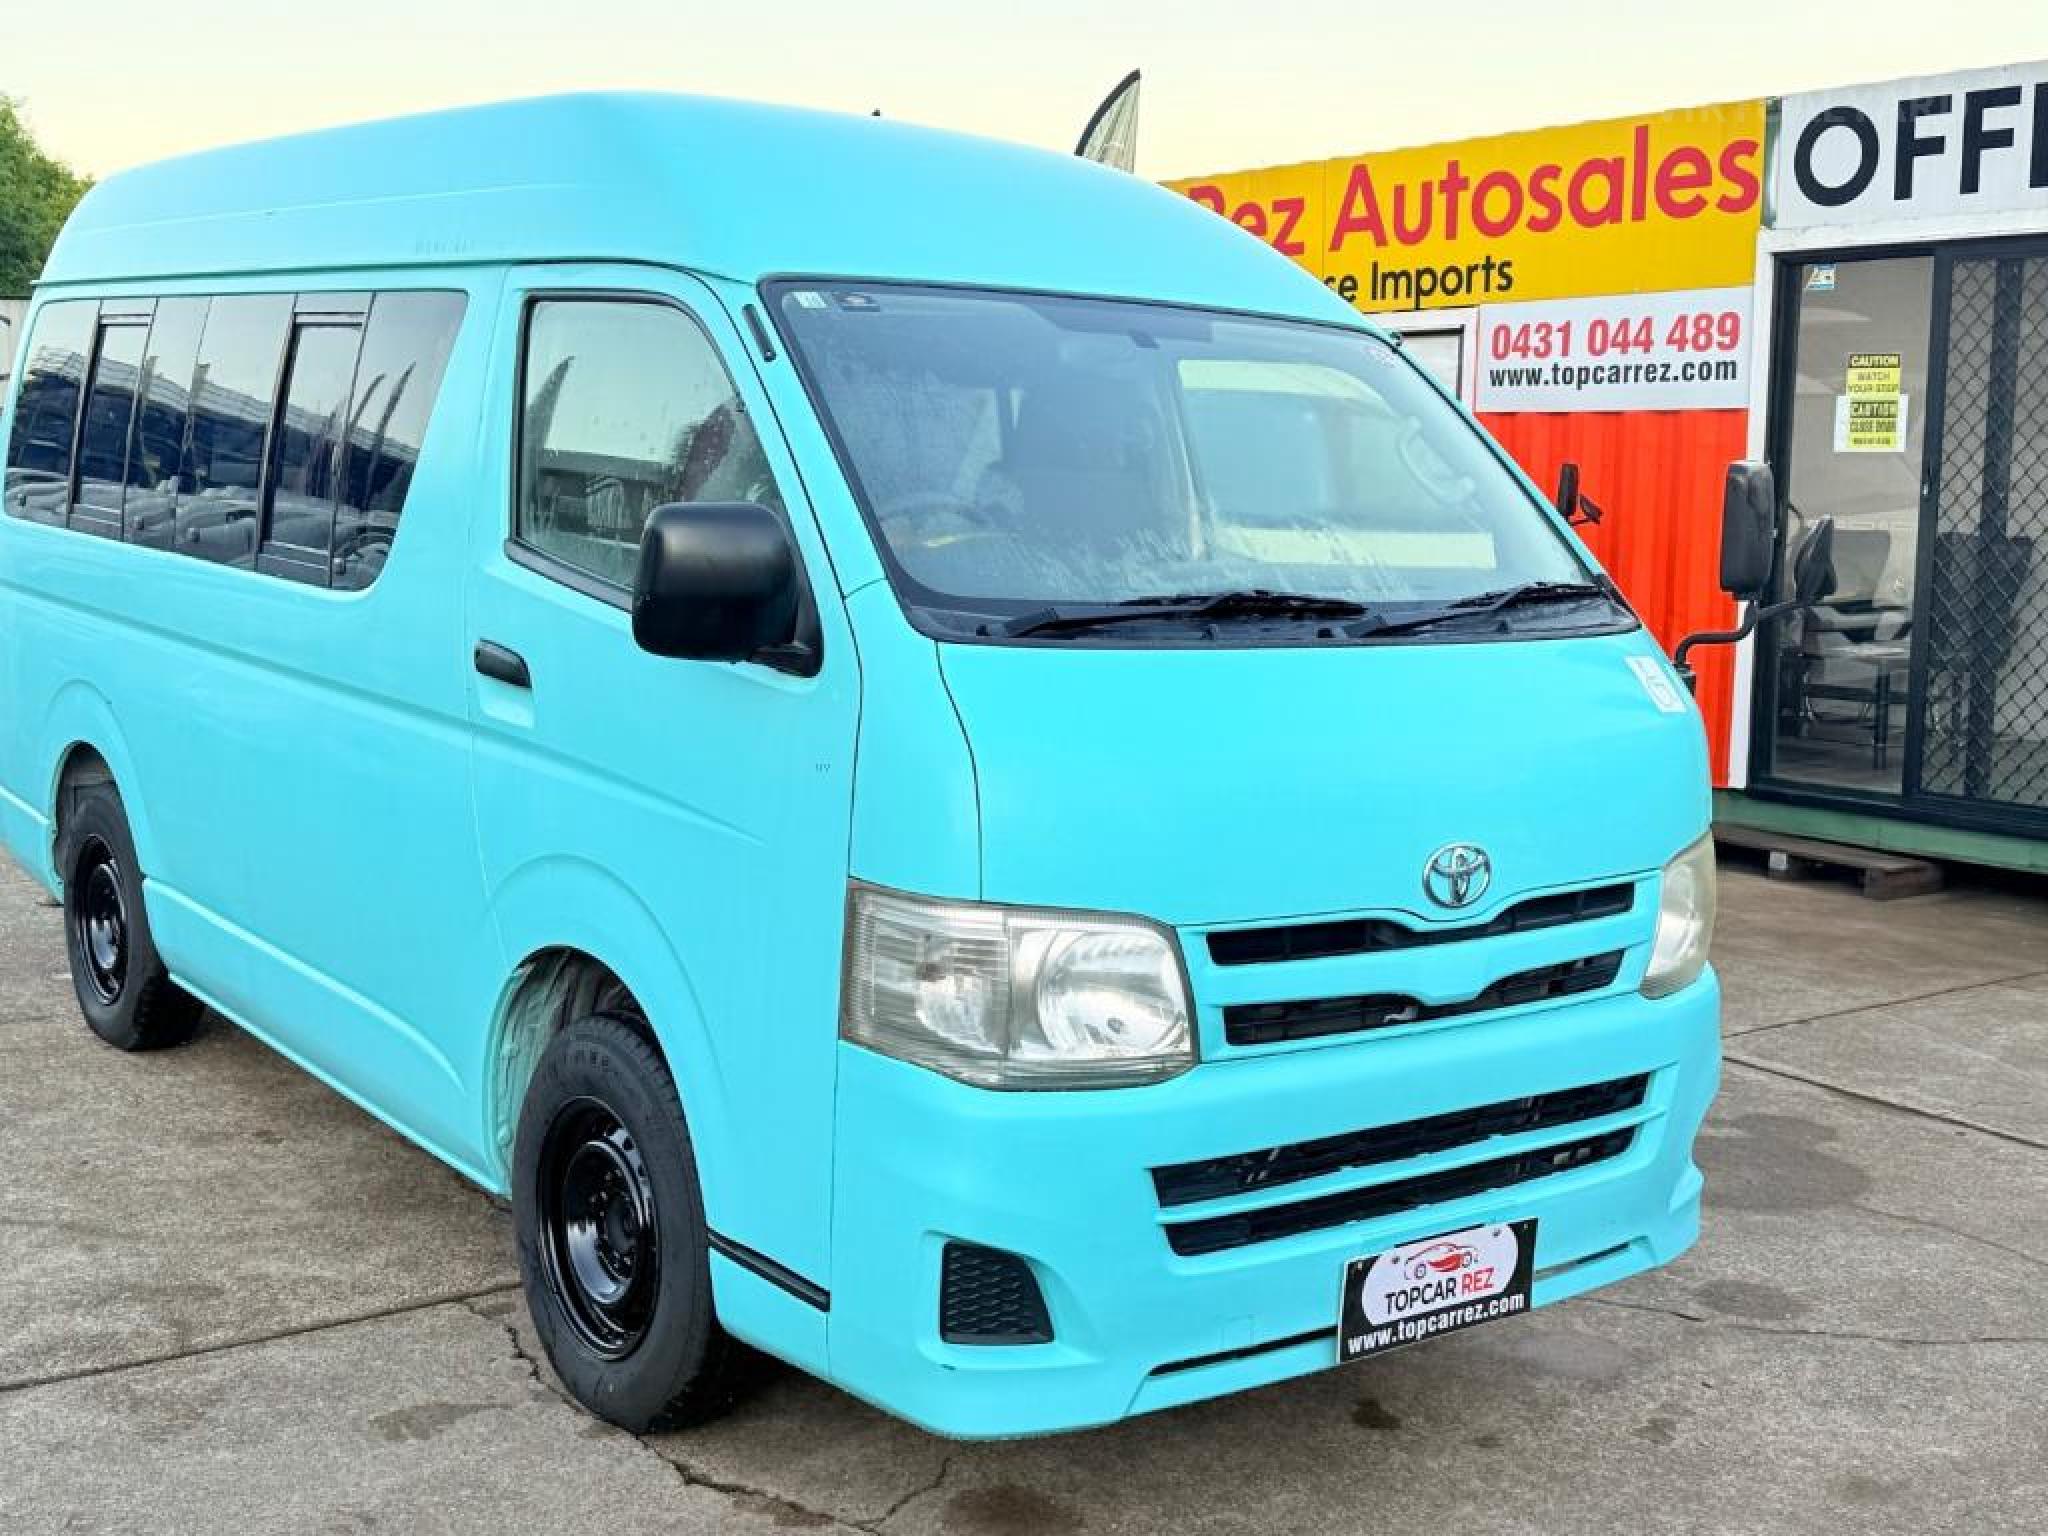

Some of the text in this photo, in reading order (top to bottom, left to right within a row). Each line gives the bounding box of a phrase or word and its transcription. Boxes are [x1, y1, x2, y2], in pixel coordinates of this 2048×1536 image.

[1329, 124, 1761, 252] Autosales
[1371, 255, 1513, 309] Imports
[1491, 311, 1741, 360] 0431 044 489
[1489, 359, 1738, 391] www.topcarrez.com
[1384, 1267, 1495, 1315] TOPCAR REZ
[1348, 1293, 1526, 1353] www.topcarrez.com
